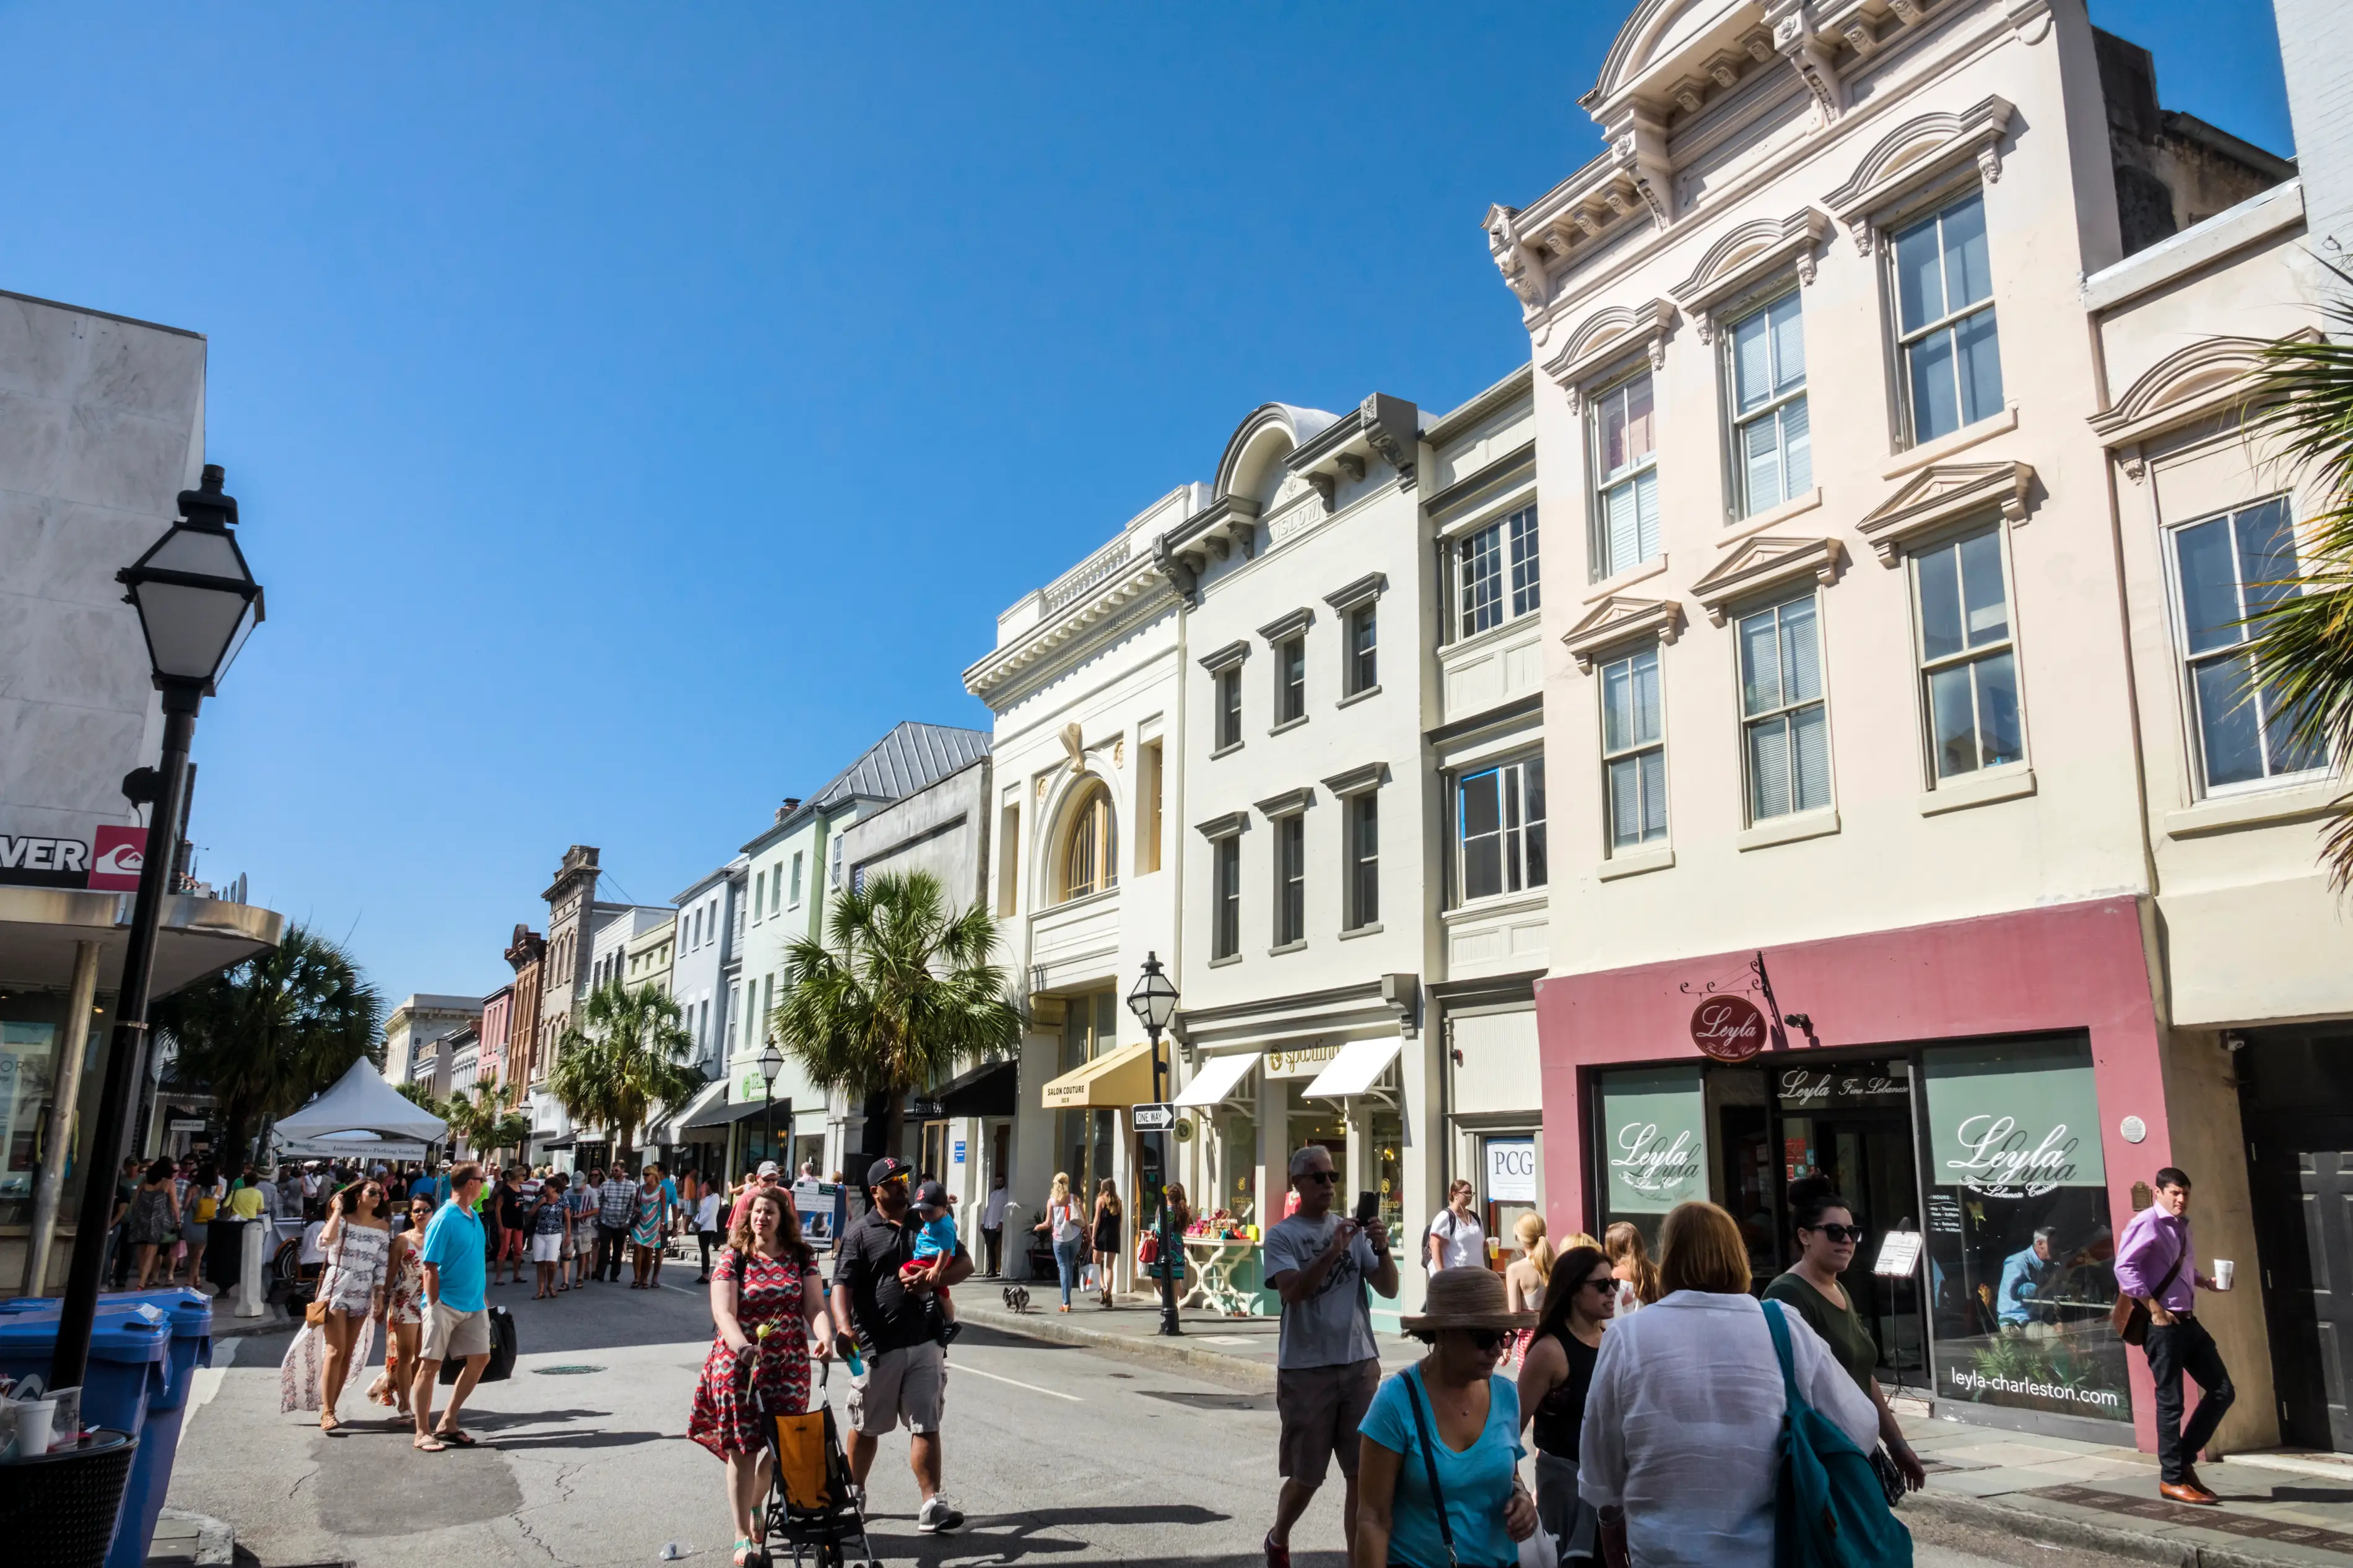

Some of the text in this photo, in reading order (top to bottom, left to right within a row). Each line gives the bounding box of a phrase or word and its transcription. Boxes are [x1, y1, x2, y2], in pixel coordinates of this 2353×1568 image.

[1696, 1005, 1757, 1046] Leyla
[413, 1037, 421, 1060] BOB
[1048, 1085, 1084, 1096] SALON COUTURE
[1777, 1070, 1909, 1105] Leyla Fine Lebanese
[1137, 1112, 1162, 1122] ONE WAY
[1611, 1122, 1690, 1179] Leyla
[1947, 1115, 2067, 1184] Leyla
[1494, 1151, 1534, 1175] PCG
[1619, 1171, 1633, 1185] Fine
[1959, 1175, 2059, 1198] Fine Lebanese Cuisine
[1951, 1366, 2118, 1406] leyla-charleston.com
